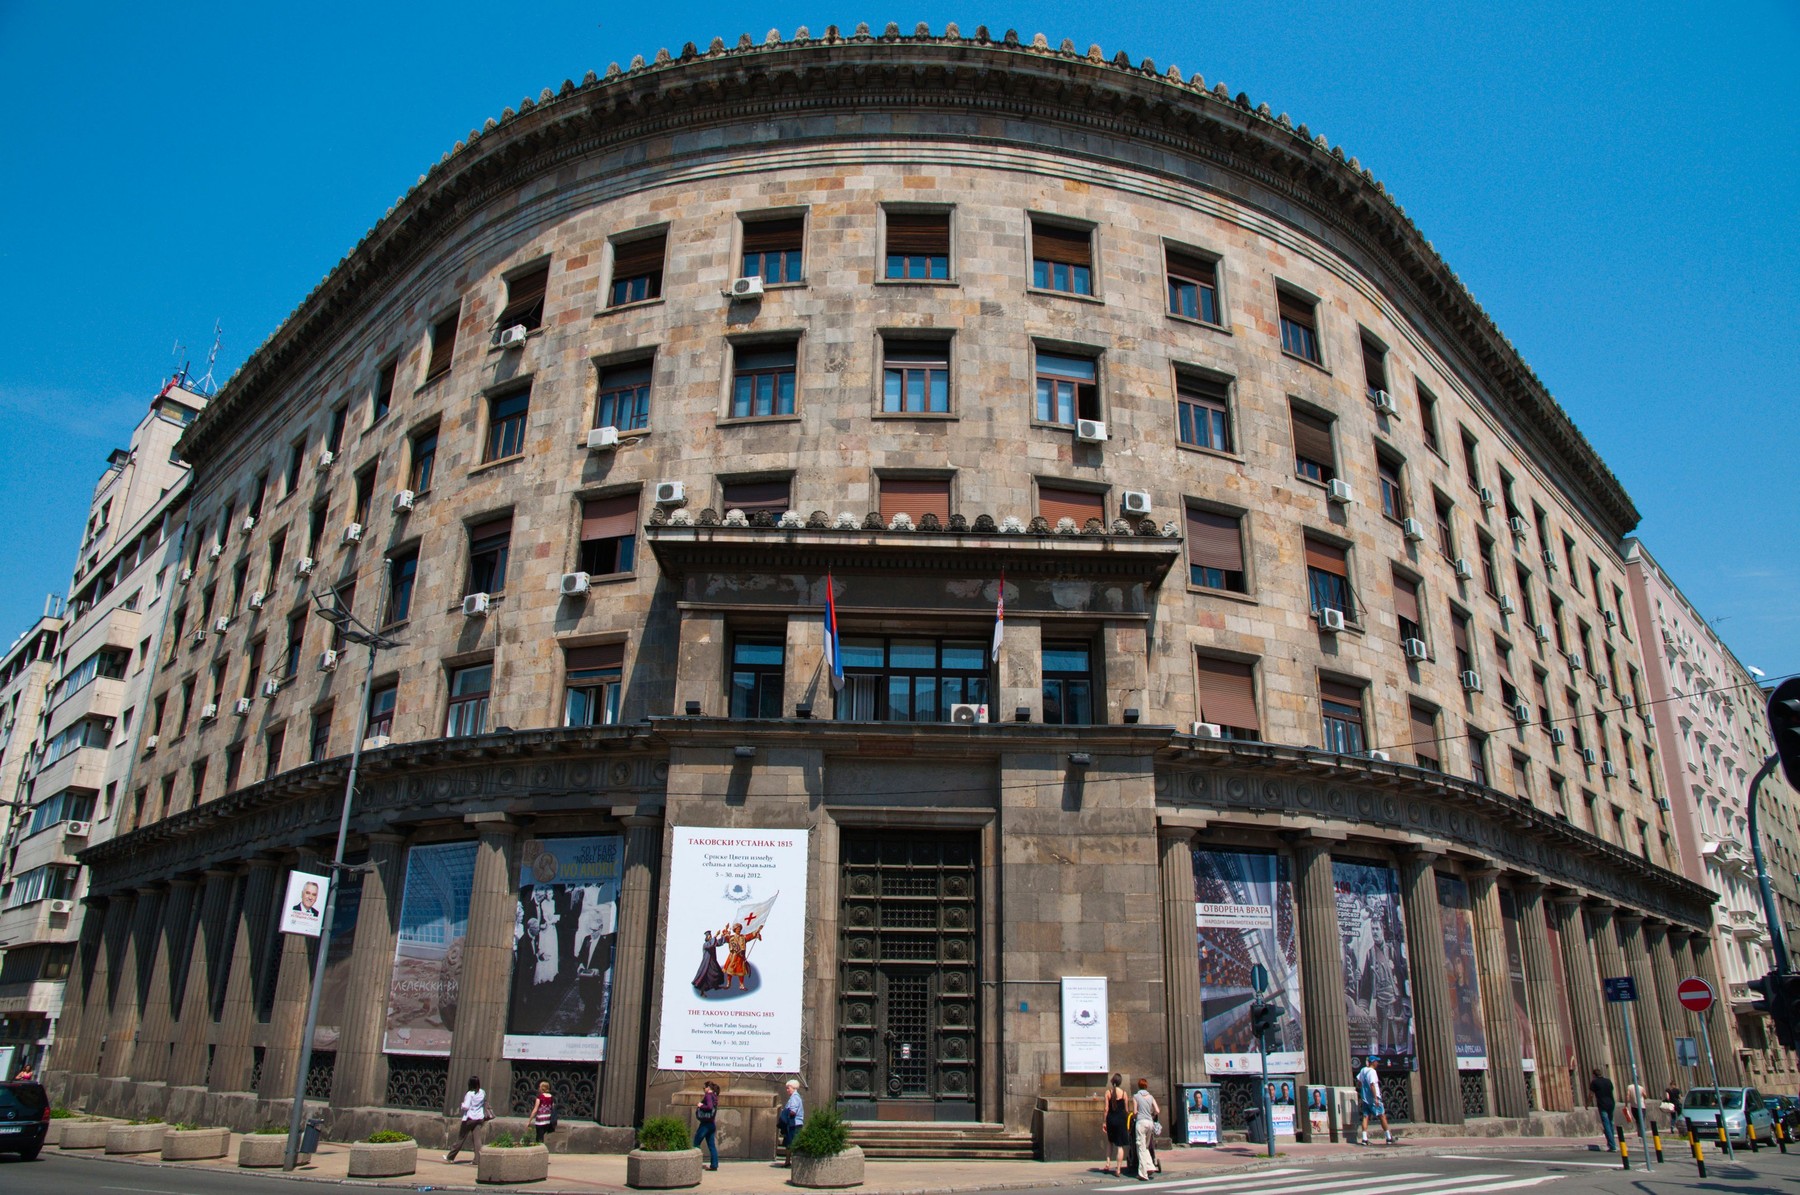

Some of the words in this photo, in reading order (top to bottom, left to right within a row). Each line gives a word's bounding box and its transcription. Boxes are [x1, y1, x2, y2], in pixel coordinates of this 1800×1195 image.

[593, 844, 617, 856] YEARS
[560, 864, 578, 877] IVO
[1203, 905, 1244, 914] ОТВОРЕНА
